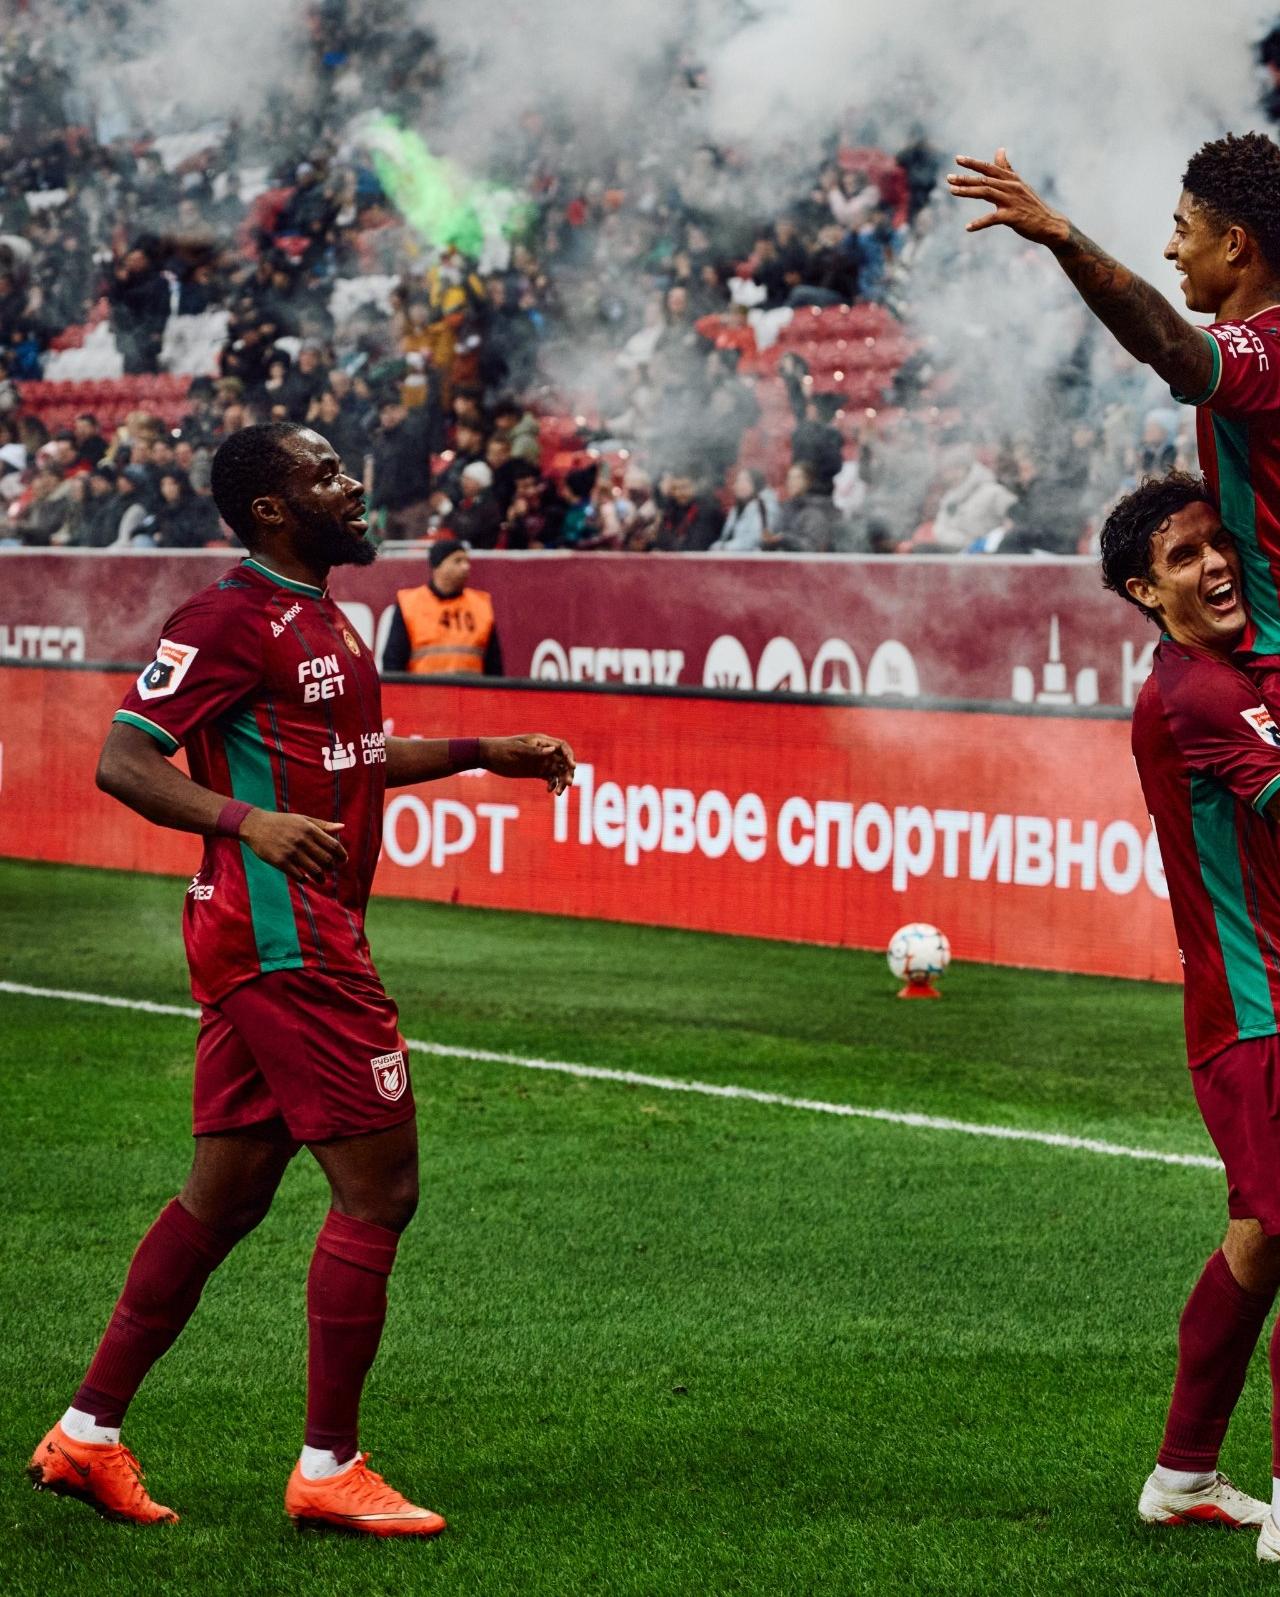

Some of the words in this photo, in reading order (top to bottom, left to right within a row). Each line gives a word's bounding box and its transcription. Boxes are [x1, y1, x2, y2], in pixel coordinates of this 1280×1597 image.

[298, 654, 340, 684] FON
[304, 675, 345, 703] BET
[553, 762, 767, 866] Первое
[372, 1053, 401, 1066] РУБИН
